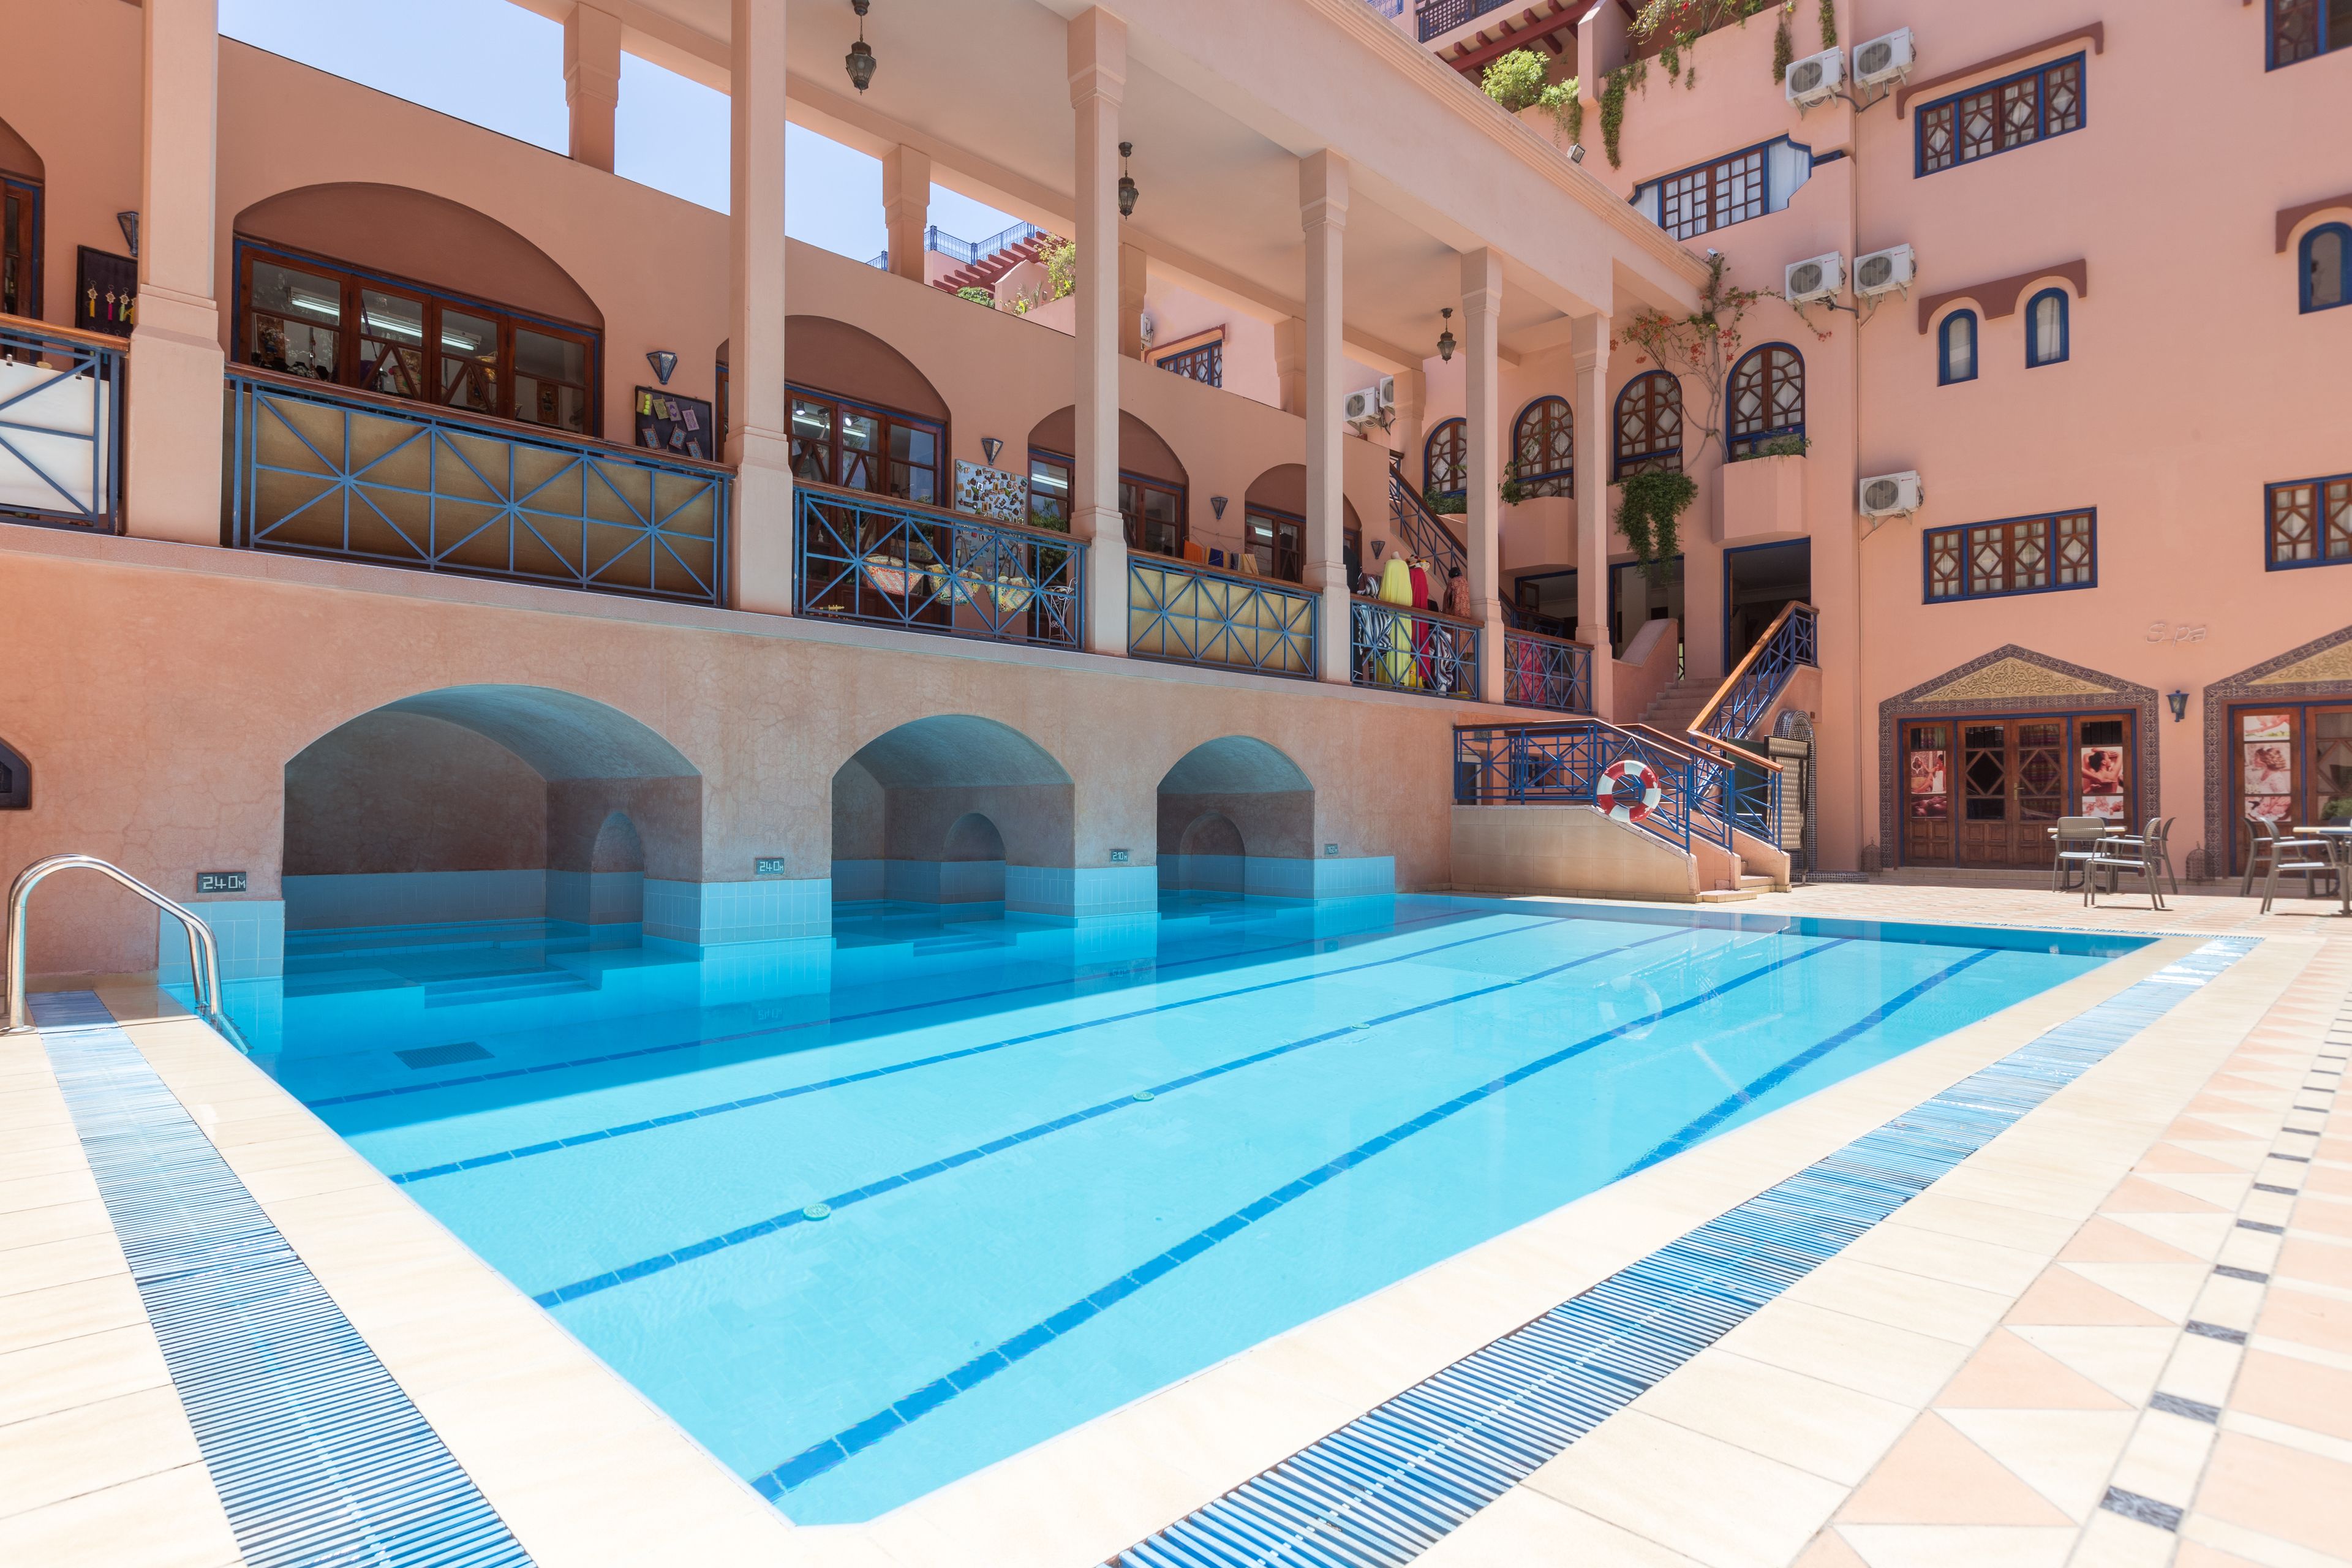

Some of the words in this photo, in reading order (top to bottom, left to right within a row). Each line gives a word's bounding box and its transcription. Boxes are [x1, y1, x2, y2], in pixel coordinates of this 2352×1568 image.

[2146, 623, 2206, 647] Spa
[760, 861, 784, 872] 2.40M
[203, 875, 246, 889] 2.40M
